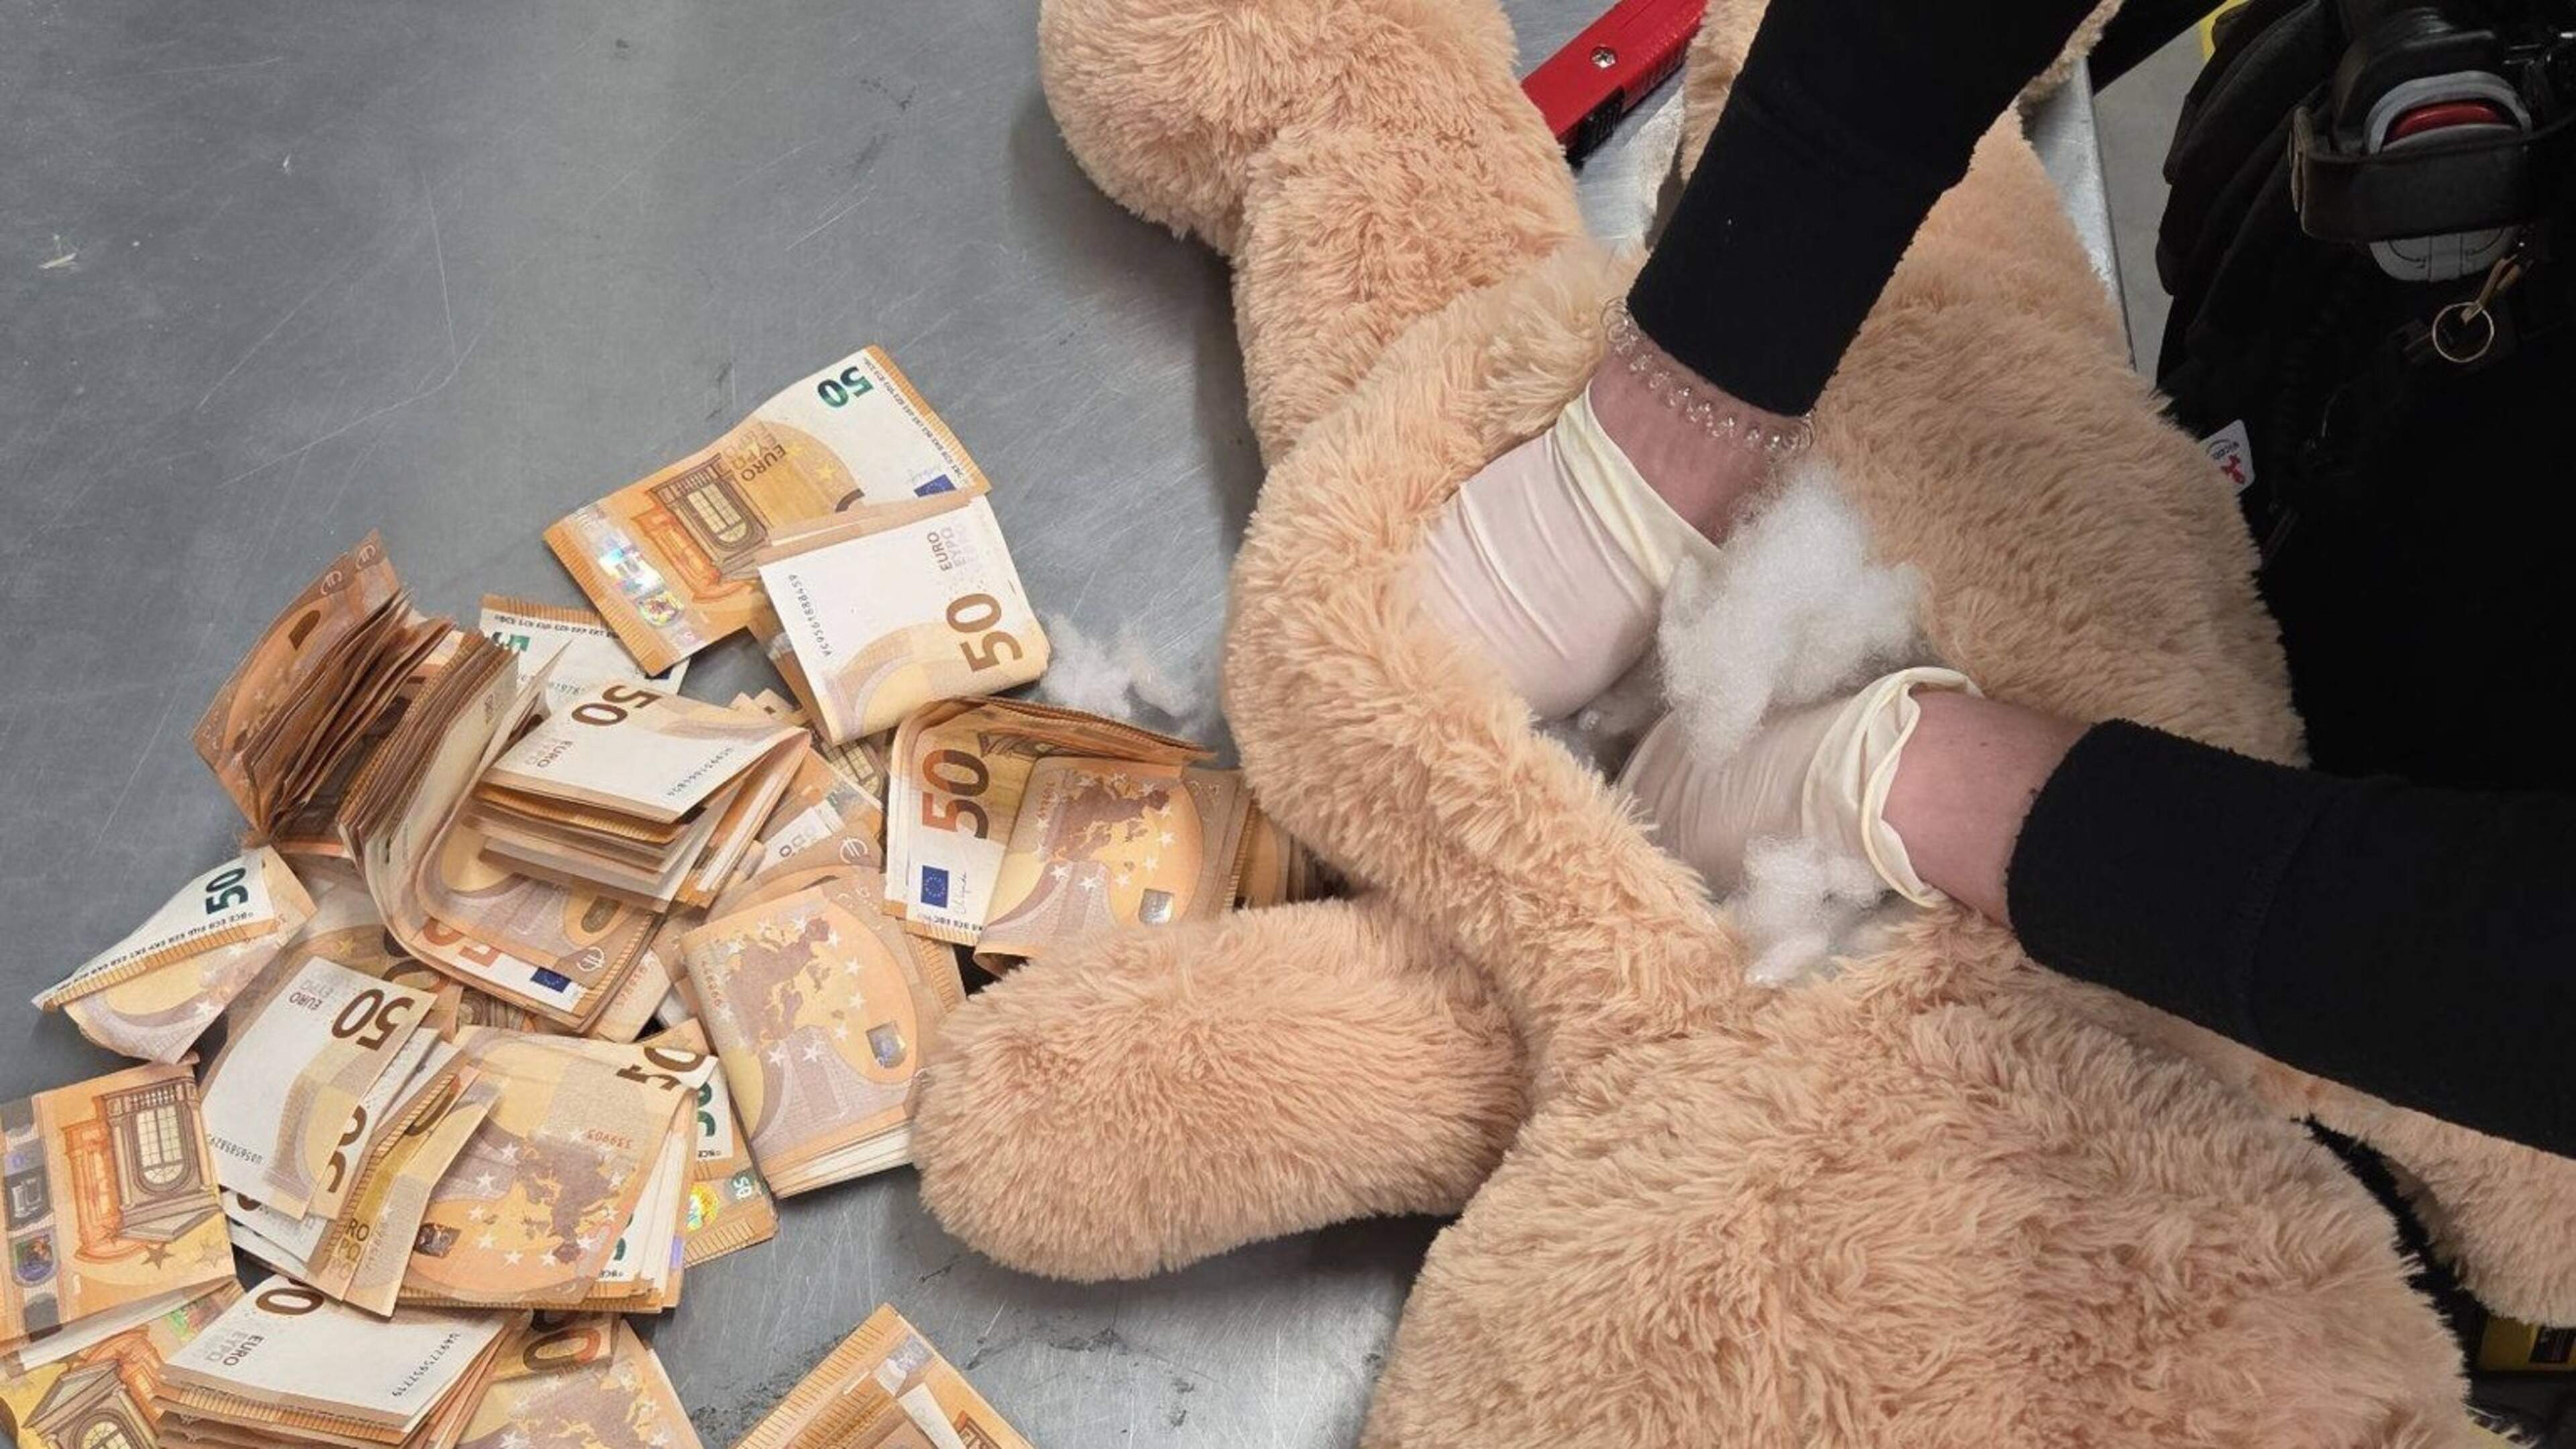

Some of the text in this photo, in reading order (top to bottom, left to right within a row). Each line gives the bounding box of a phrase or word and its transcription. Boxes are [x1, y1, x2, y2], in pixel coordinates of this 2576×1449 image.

[817, 366, 874, 408] 50
[741, 444, 786, 482] EURO
[927, 531, 953, 572] EURO
[946, 593, 1023, 673] 50
[571, 684, 662, 727] 50
[537, 740, 573, 768] EURO
[922, 748, 989, 841] 50
[205, 867, 249, 915] 50
[288, 991, 322, 1012] EURO
[331, 988, 415, 1051] 50
[345, 1218, 370, 1241] RO
[255, 1287, 325, 1316] 0
[223, 1334, 264, 1366] EURO
